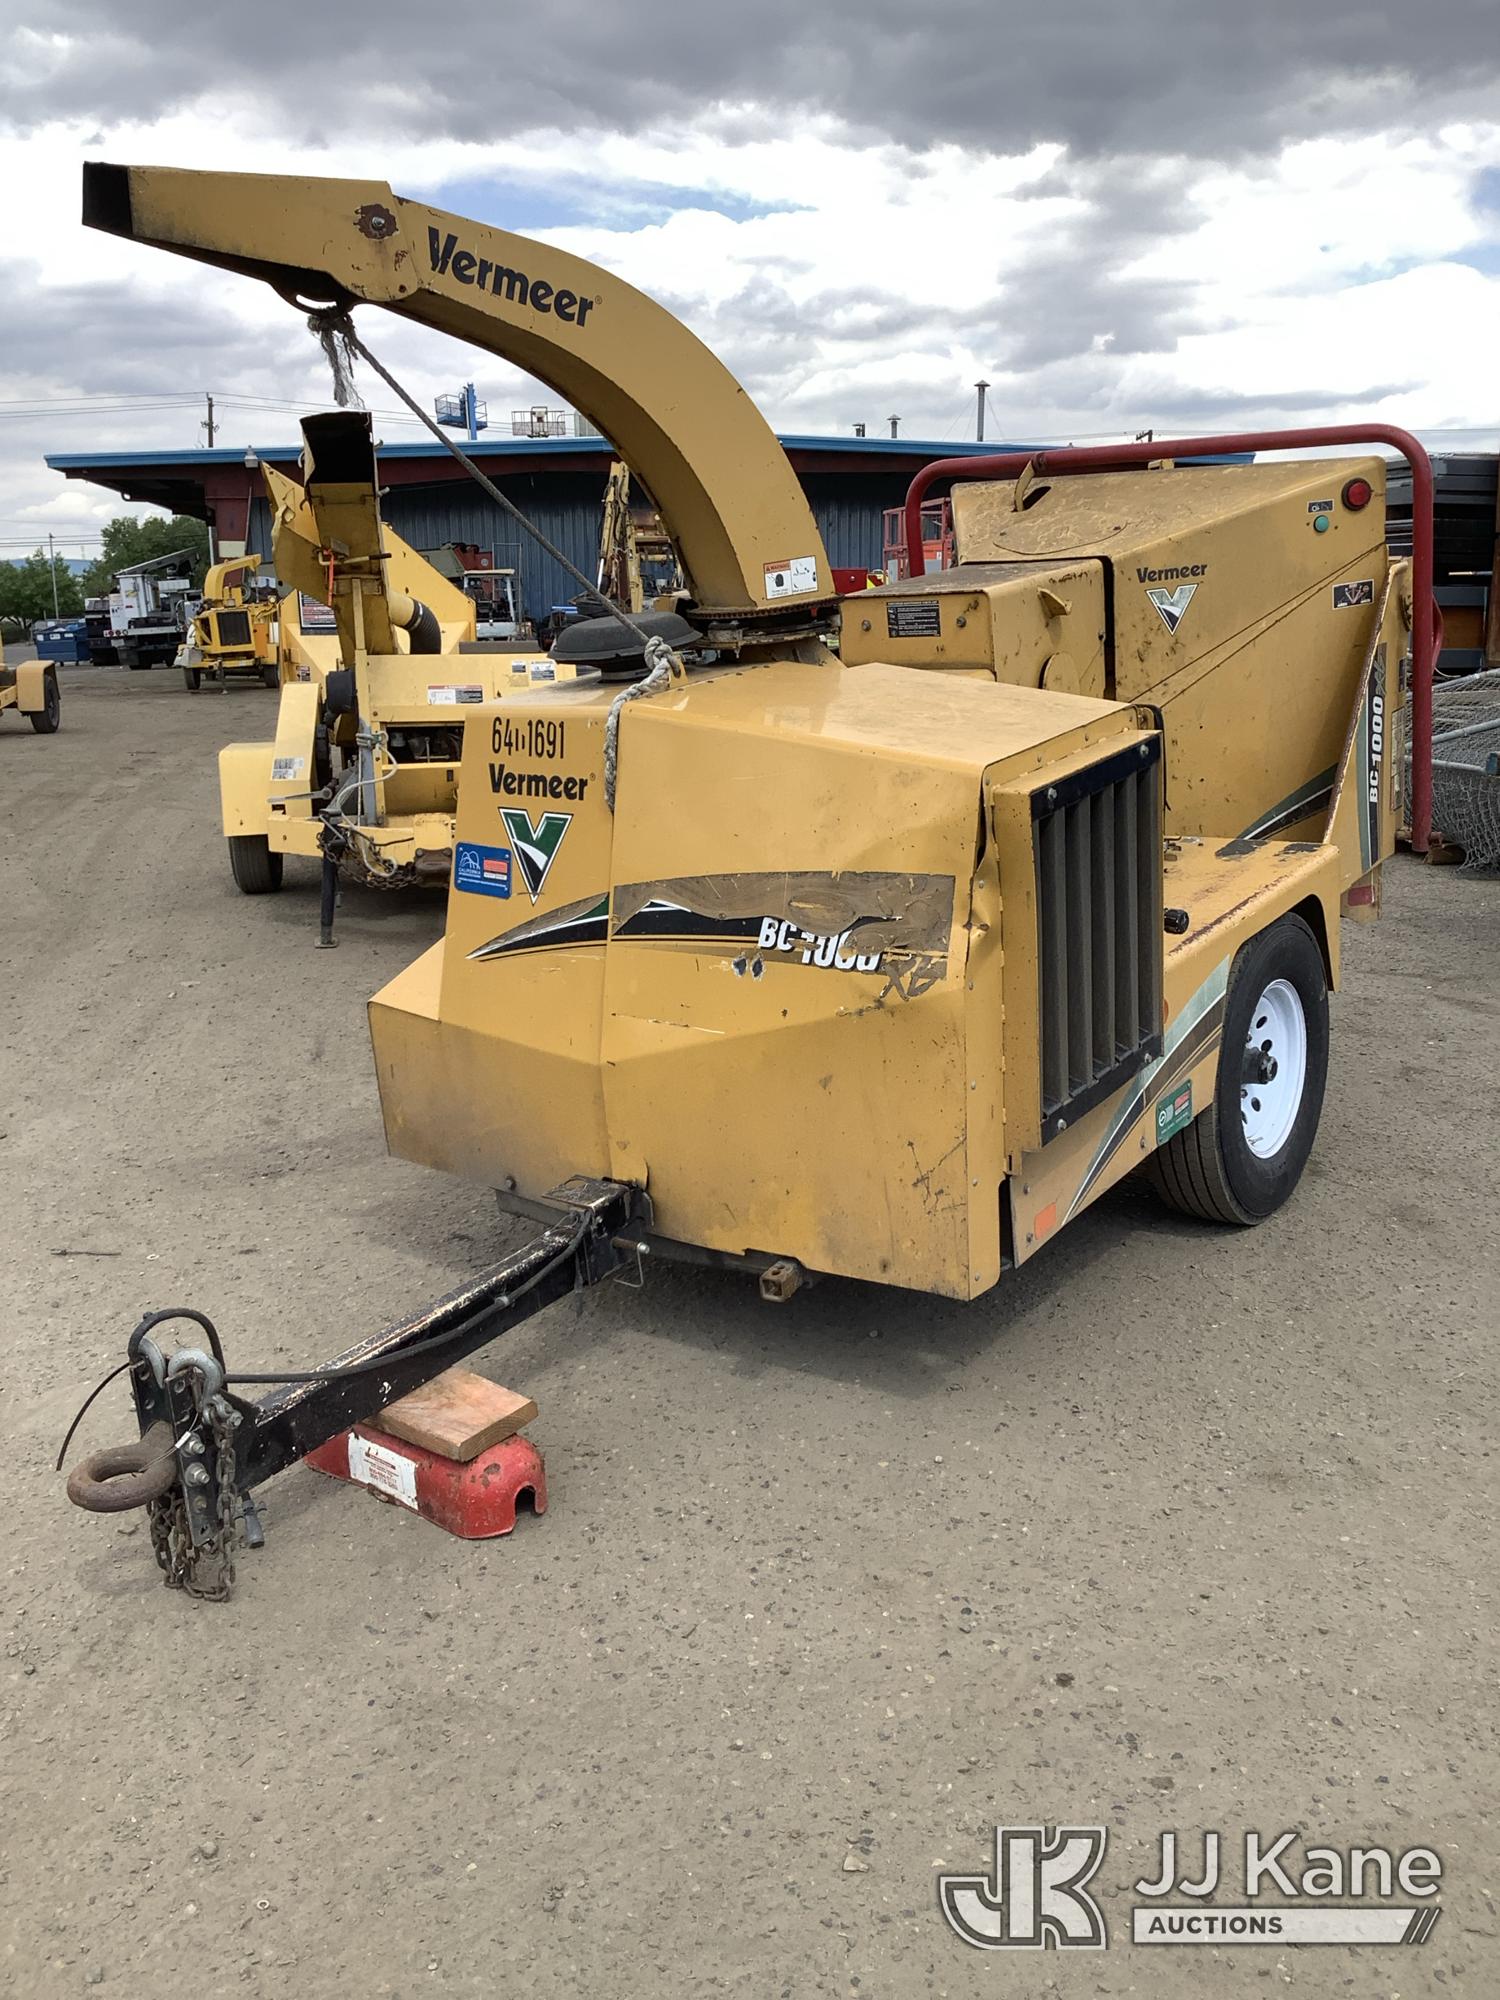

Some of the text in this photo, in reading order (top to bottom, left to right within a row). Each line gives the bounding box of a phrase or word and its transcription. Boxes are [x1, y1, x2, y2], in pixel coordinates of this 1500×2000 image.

[428, 226, 594, 327] Vermeer
[1136, 564, 1208, 584] Vermeer
[488, 763, 588, 801] Vermeer
